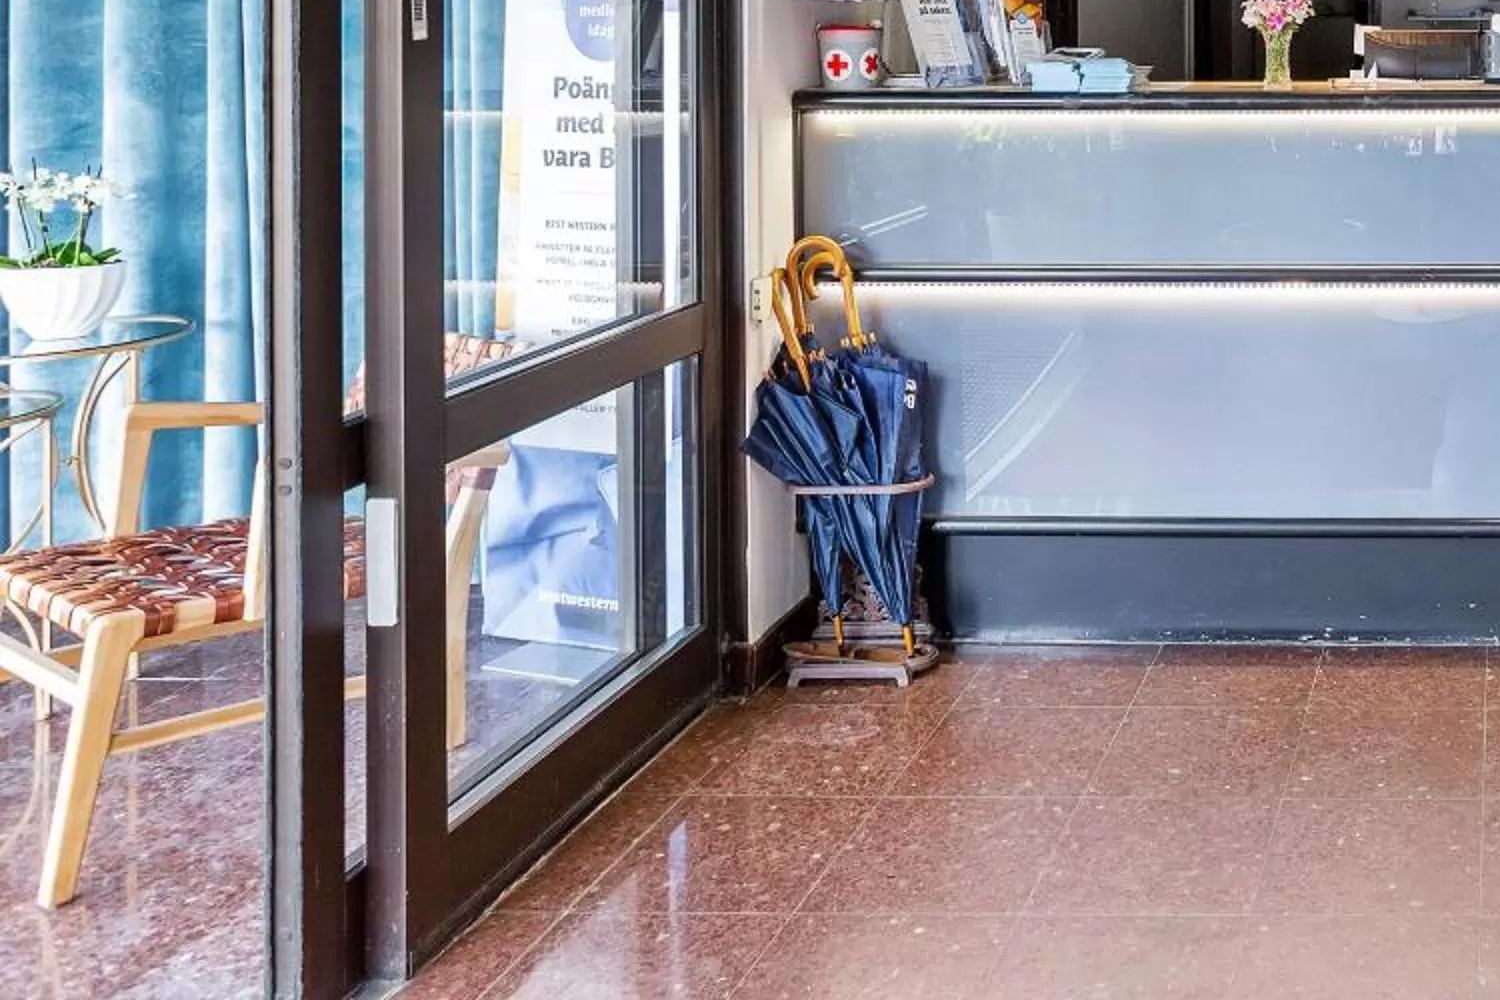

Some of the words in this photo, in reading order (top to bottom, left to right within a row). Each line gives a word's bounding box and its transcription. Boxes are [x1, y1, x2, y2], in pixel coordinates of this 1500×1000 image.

[553, 75, 616, 104] Poän
[556, 112, 604, 134] med
[543, 149, 591, 168] vara
